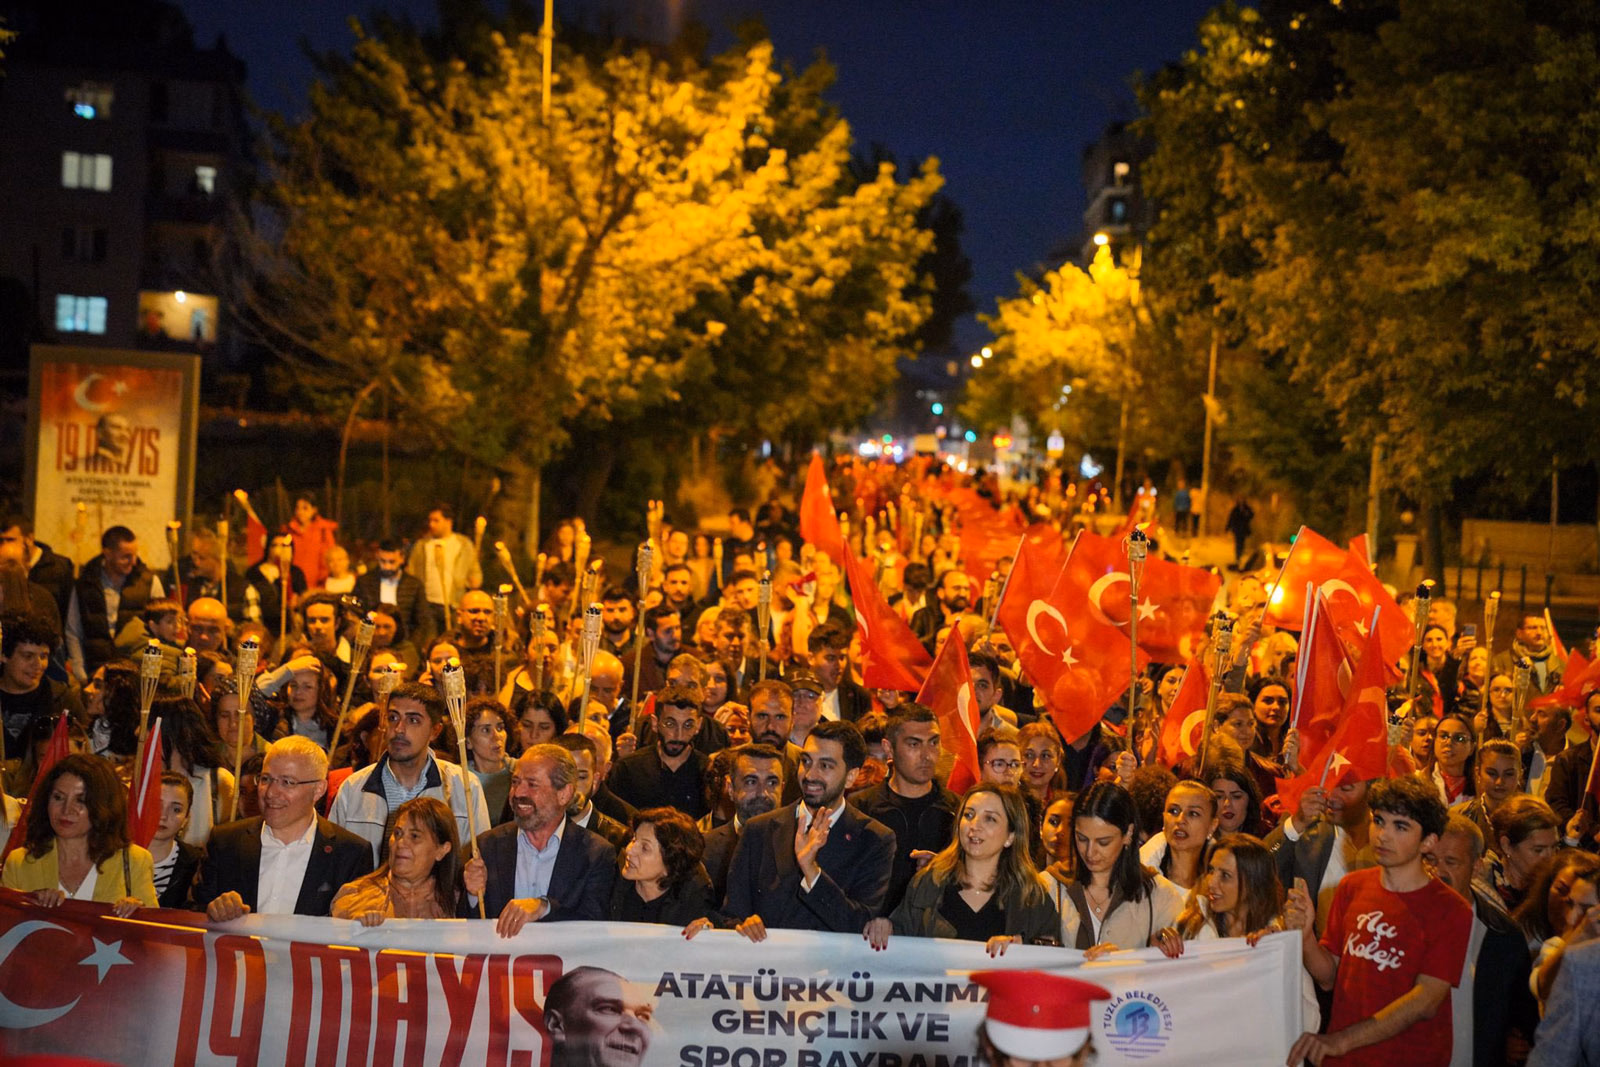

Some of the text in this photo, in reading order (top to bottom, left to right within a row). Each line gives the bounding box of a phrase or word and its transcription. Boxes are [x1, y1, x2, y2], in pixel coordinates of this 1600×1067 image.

[56, 422, 79, 472] 19
[1343, 932, 1405, 972] Koleji
[172, 931, 564, 1067] 19 MAYIS
[653, 968, 875, 1003] ATATÜRK'Ü
[896, 1012, 951, 1042] VE
[1103, 996, 1124, 1029] TUZLA
[679, 1044, 787, 1067] SPOR
